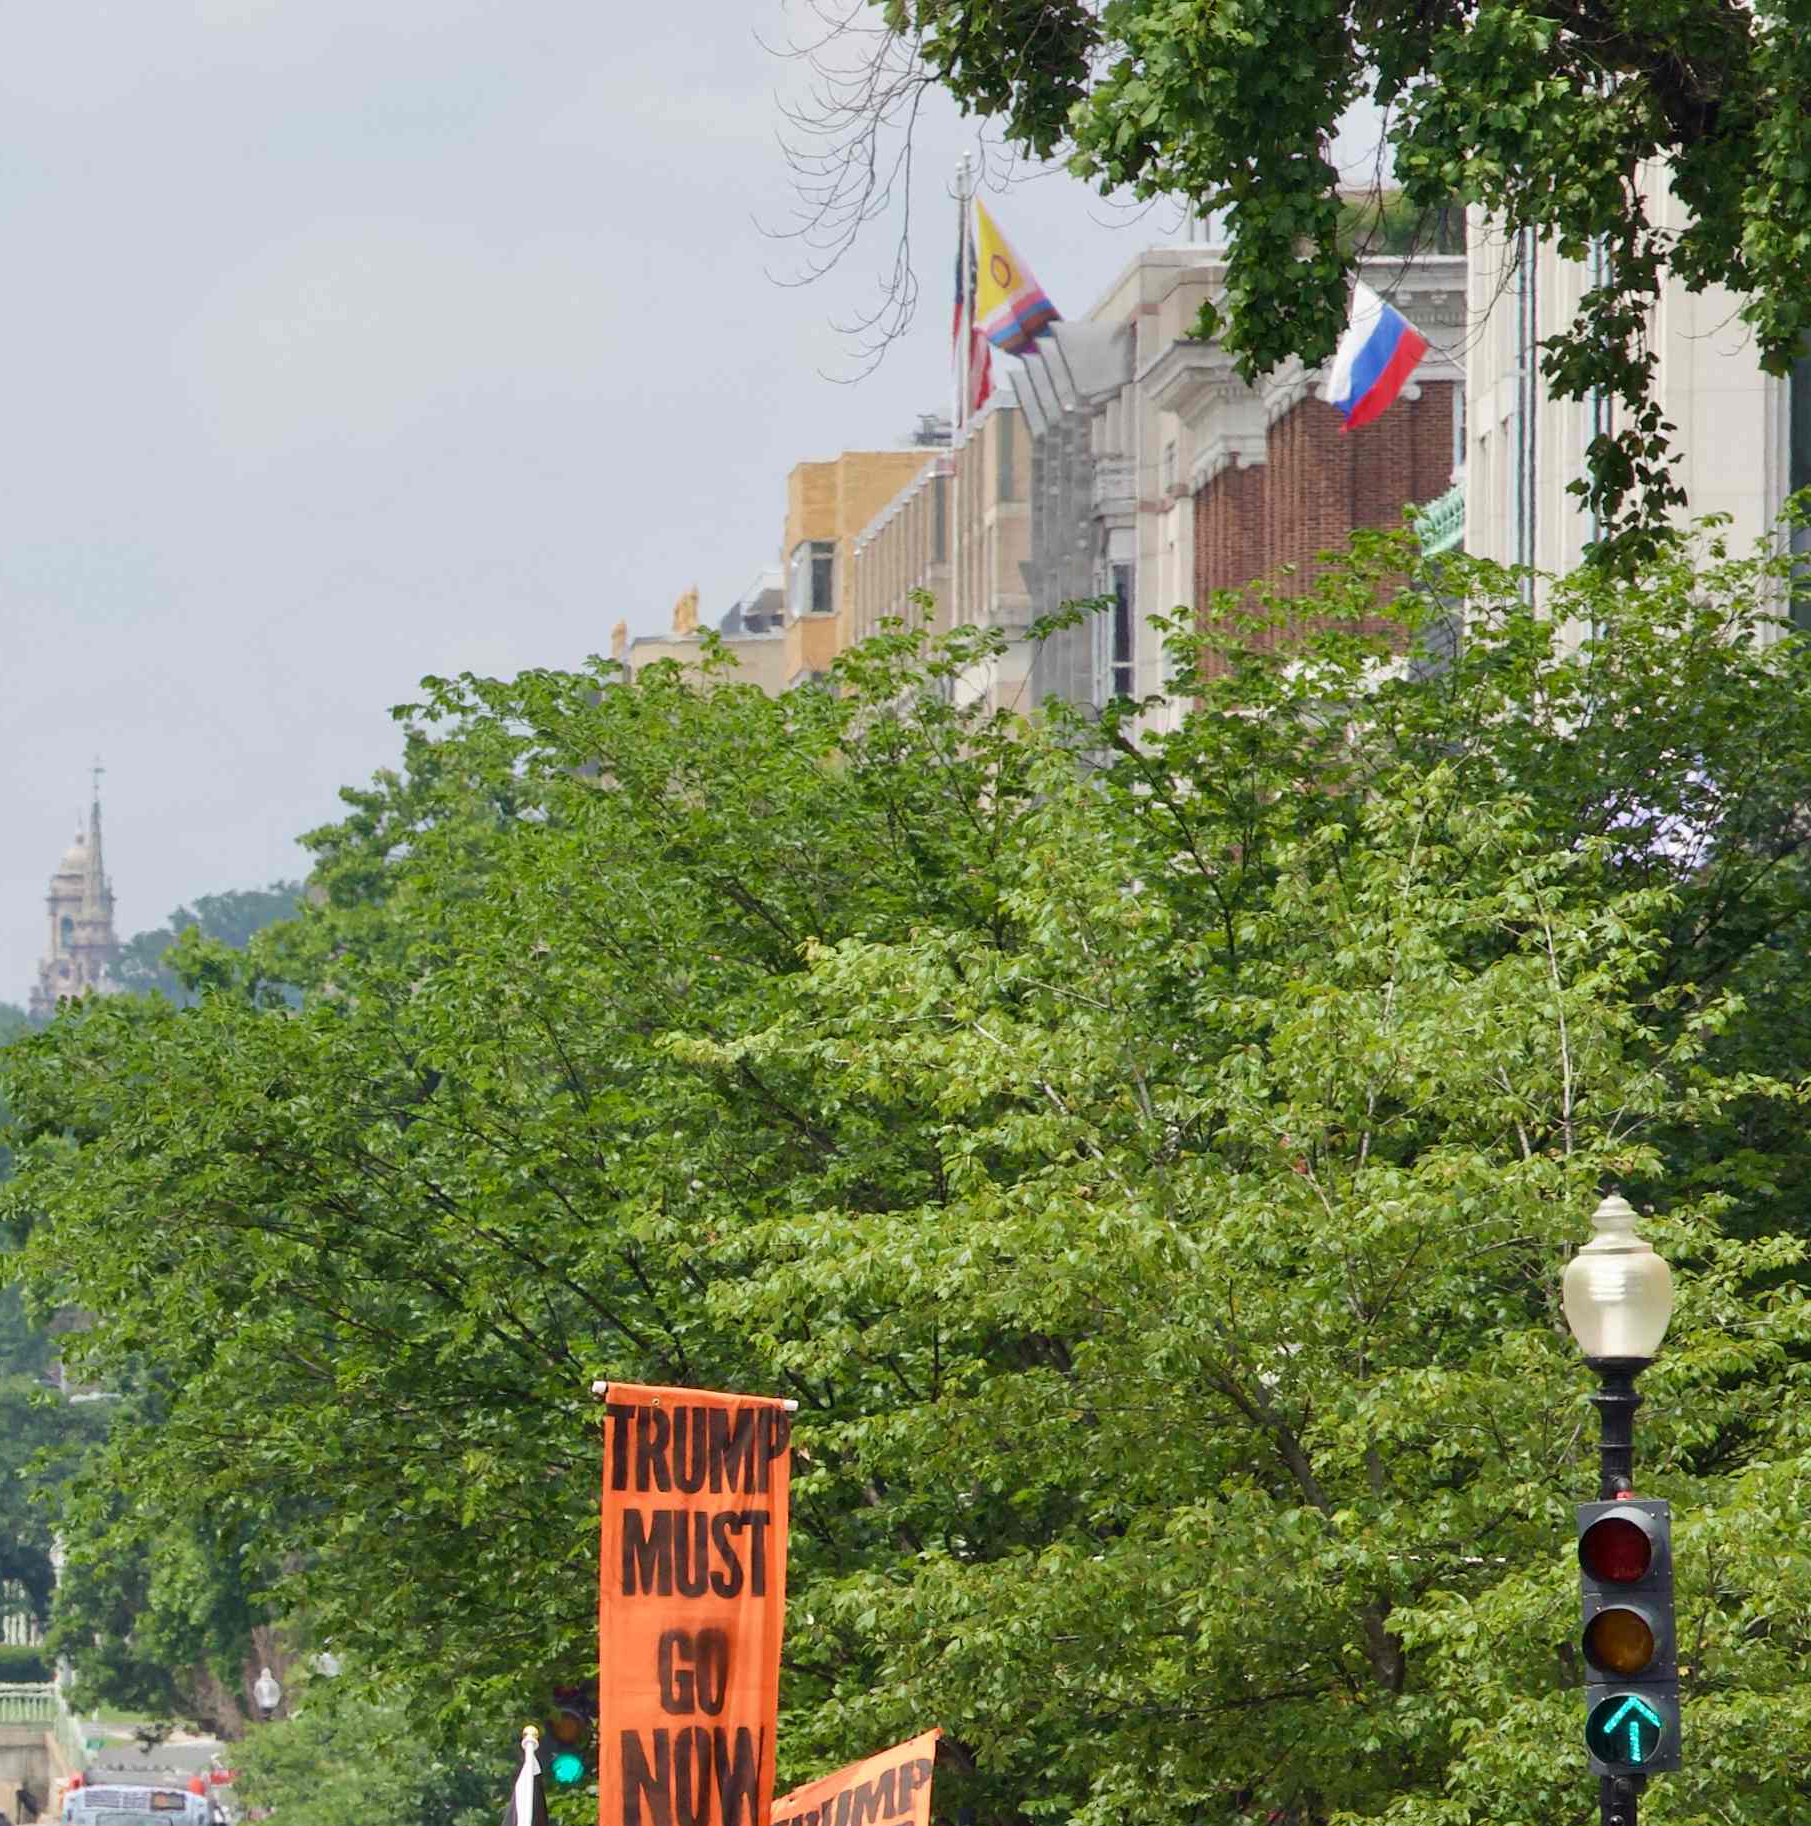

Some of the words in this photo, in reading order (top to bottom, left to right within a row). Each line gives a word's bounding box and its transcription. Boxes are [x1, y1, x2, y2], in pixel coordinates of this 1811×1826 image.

[607, 1404, 790, 1495] TRUMP
[621, 1509, 771, 1600] MUST
[658, 1626, 728, 1717] GO
